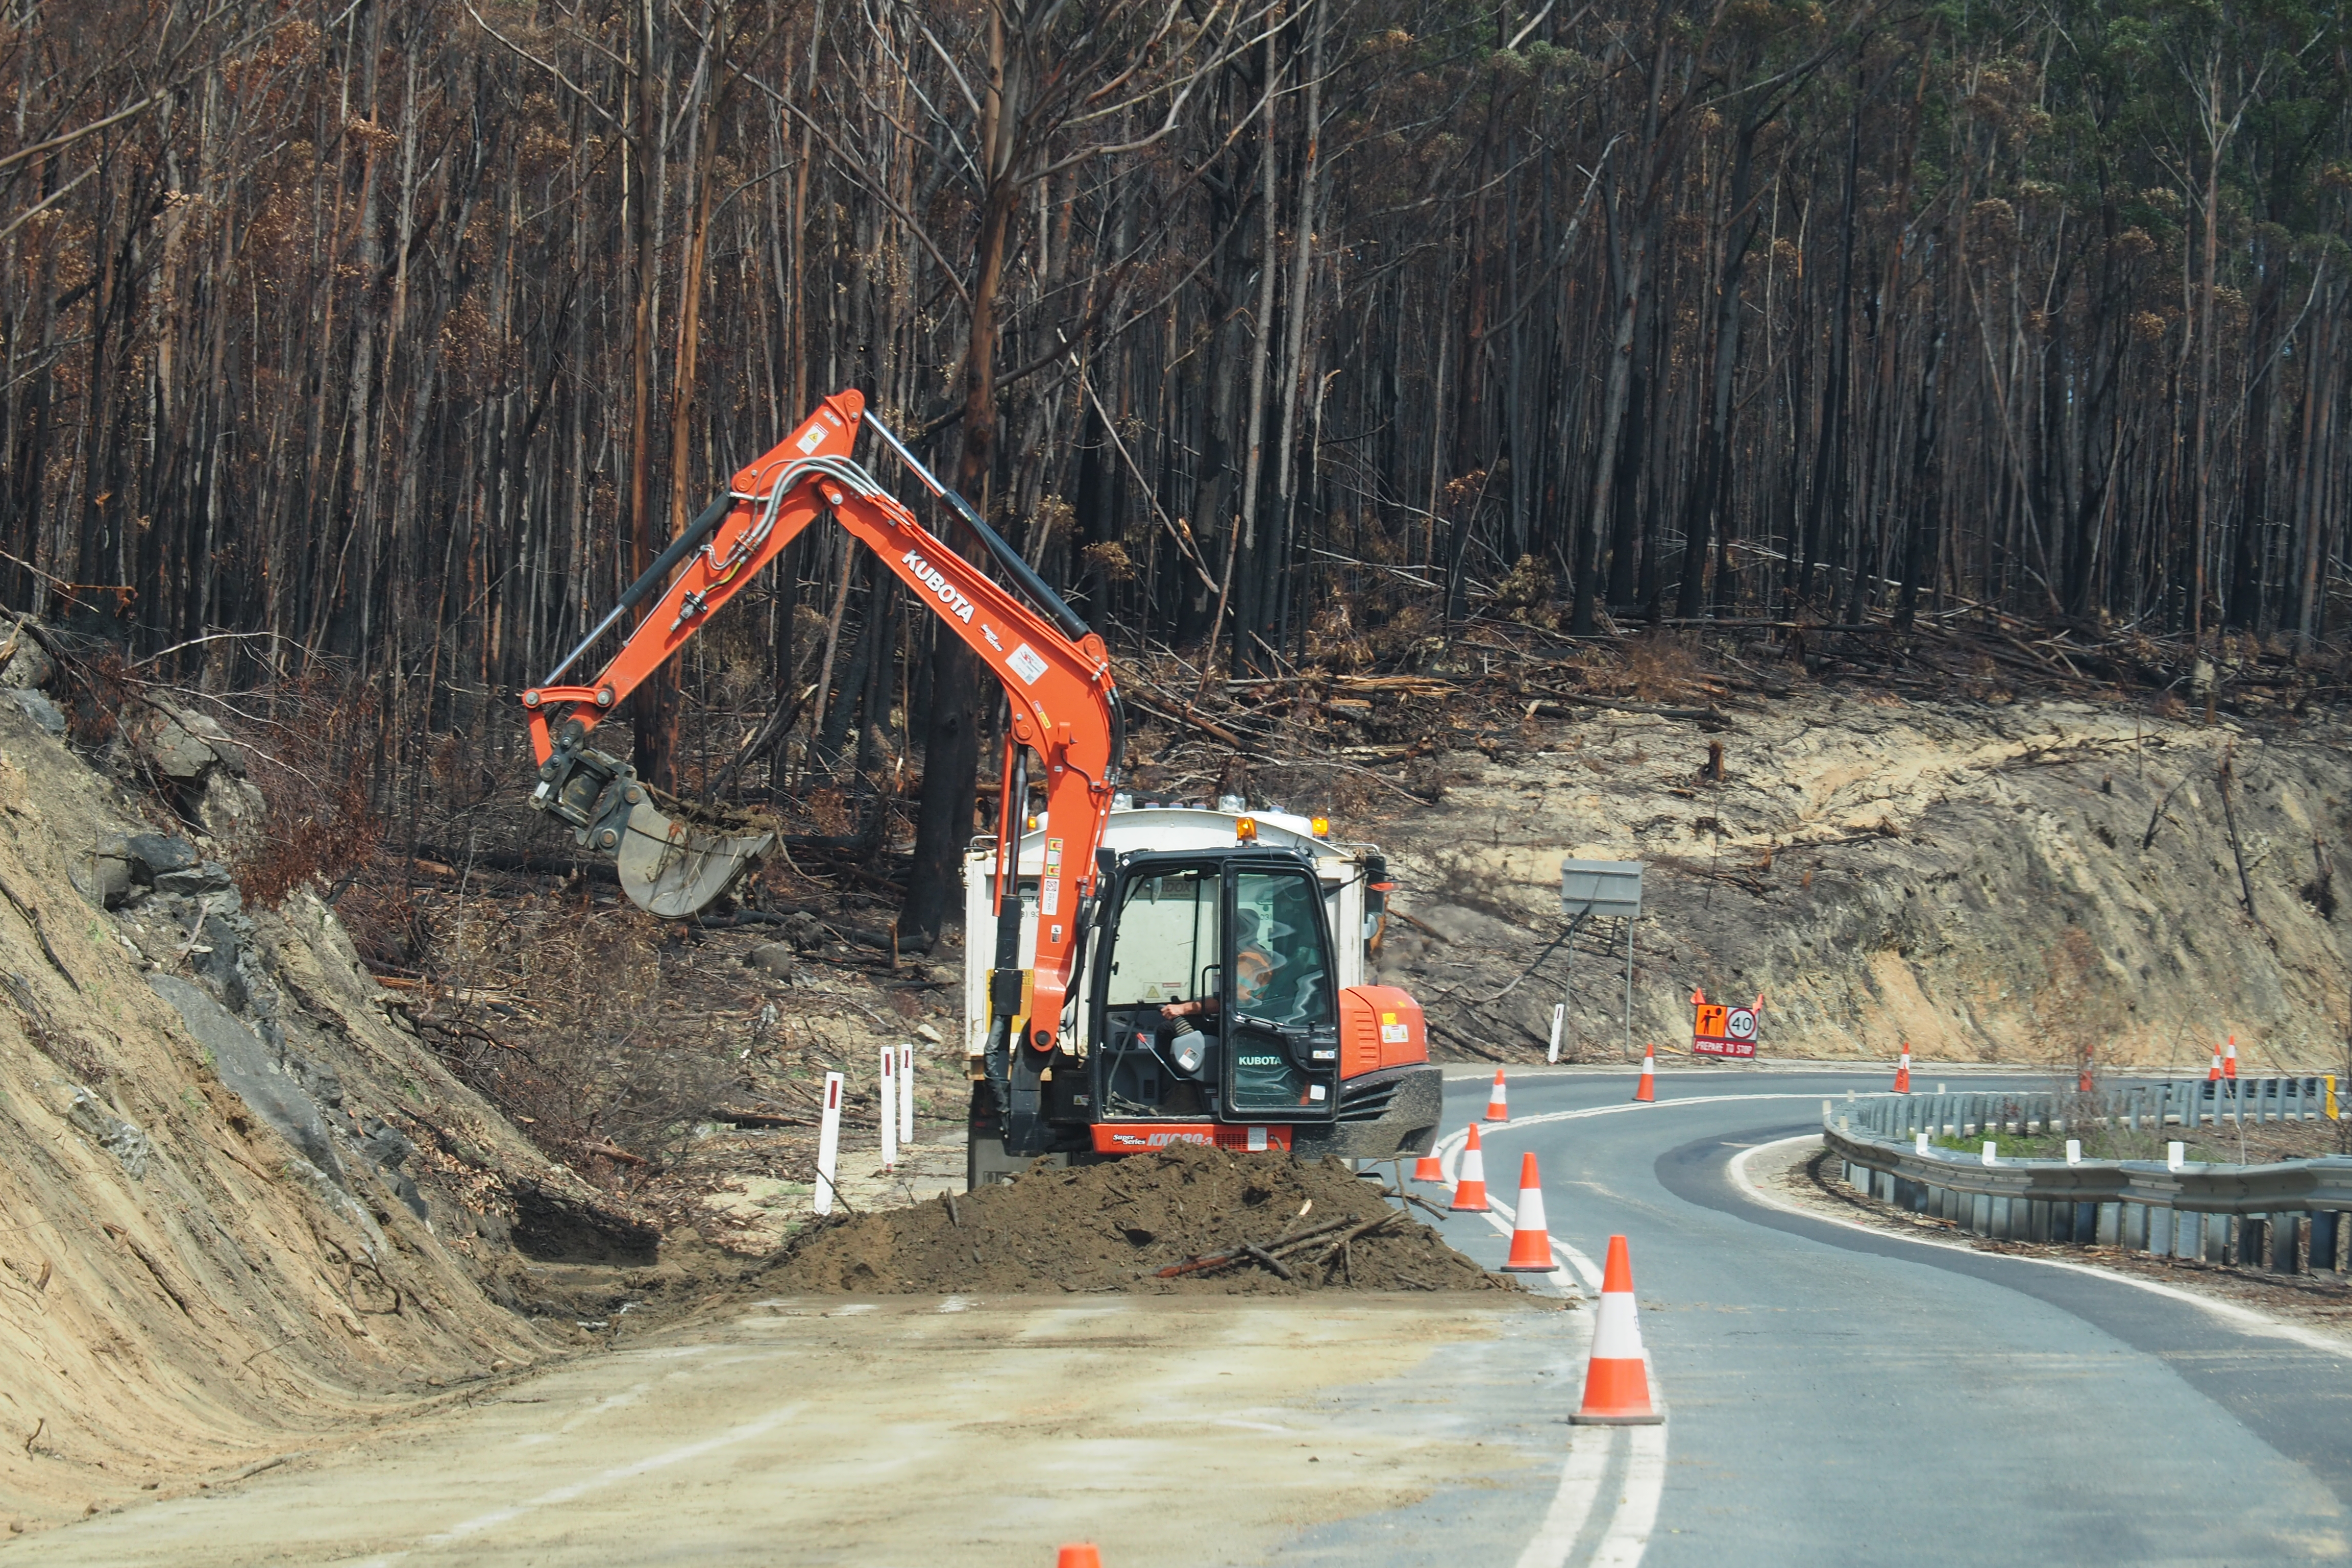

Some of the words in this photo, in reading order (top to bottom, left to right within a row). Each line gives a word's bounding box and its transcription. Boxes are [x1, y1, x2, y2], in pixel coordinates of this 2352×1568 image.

[901, 549, 974, 624] KUBOTA
[1731, 1017, 1752, 1031] 40
[1696, 1041, 1724, 1052] PREPARE
[1726, 1043, 1734, 1053] TO
[1736, 1045, 1752, 1055] STOP
[1239, 1057, 1282, 1065] KUBOTA
